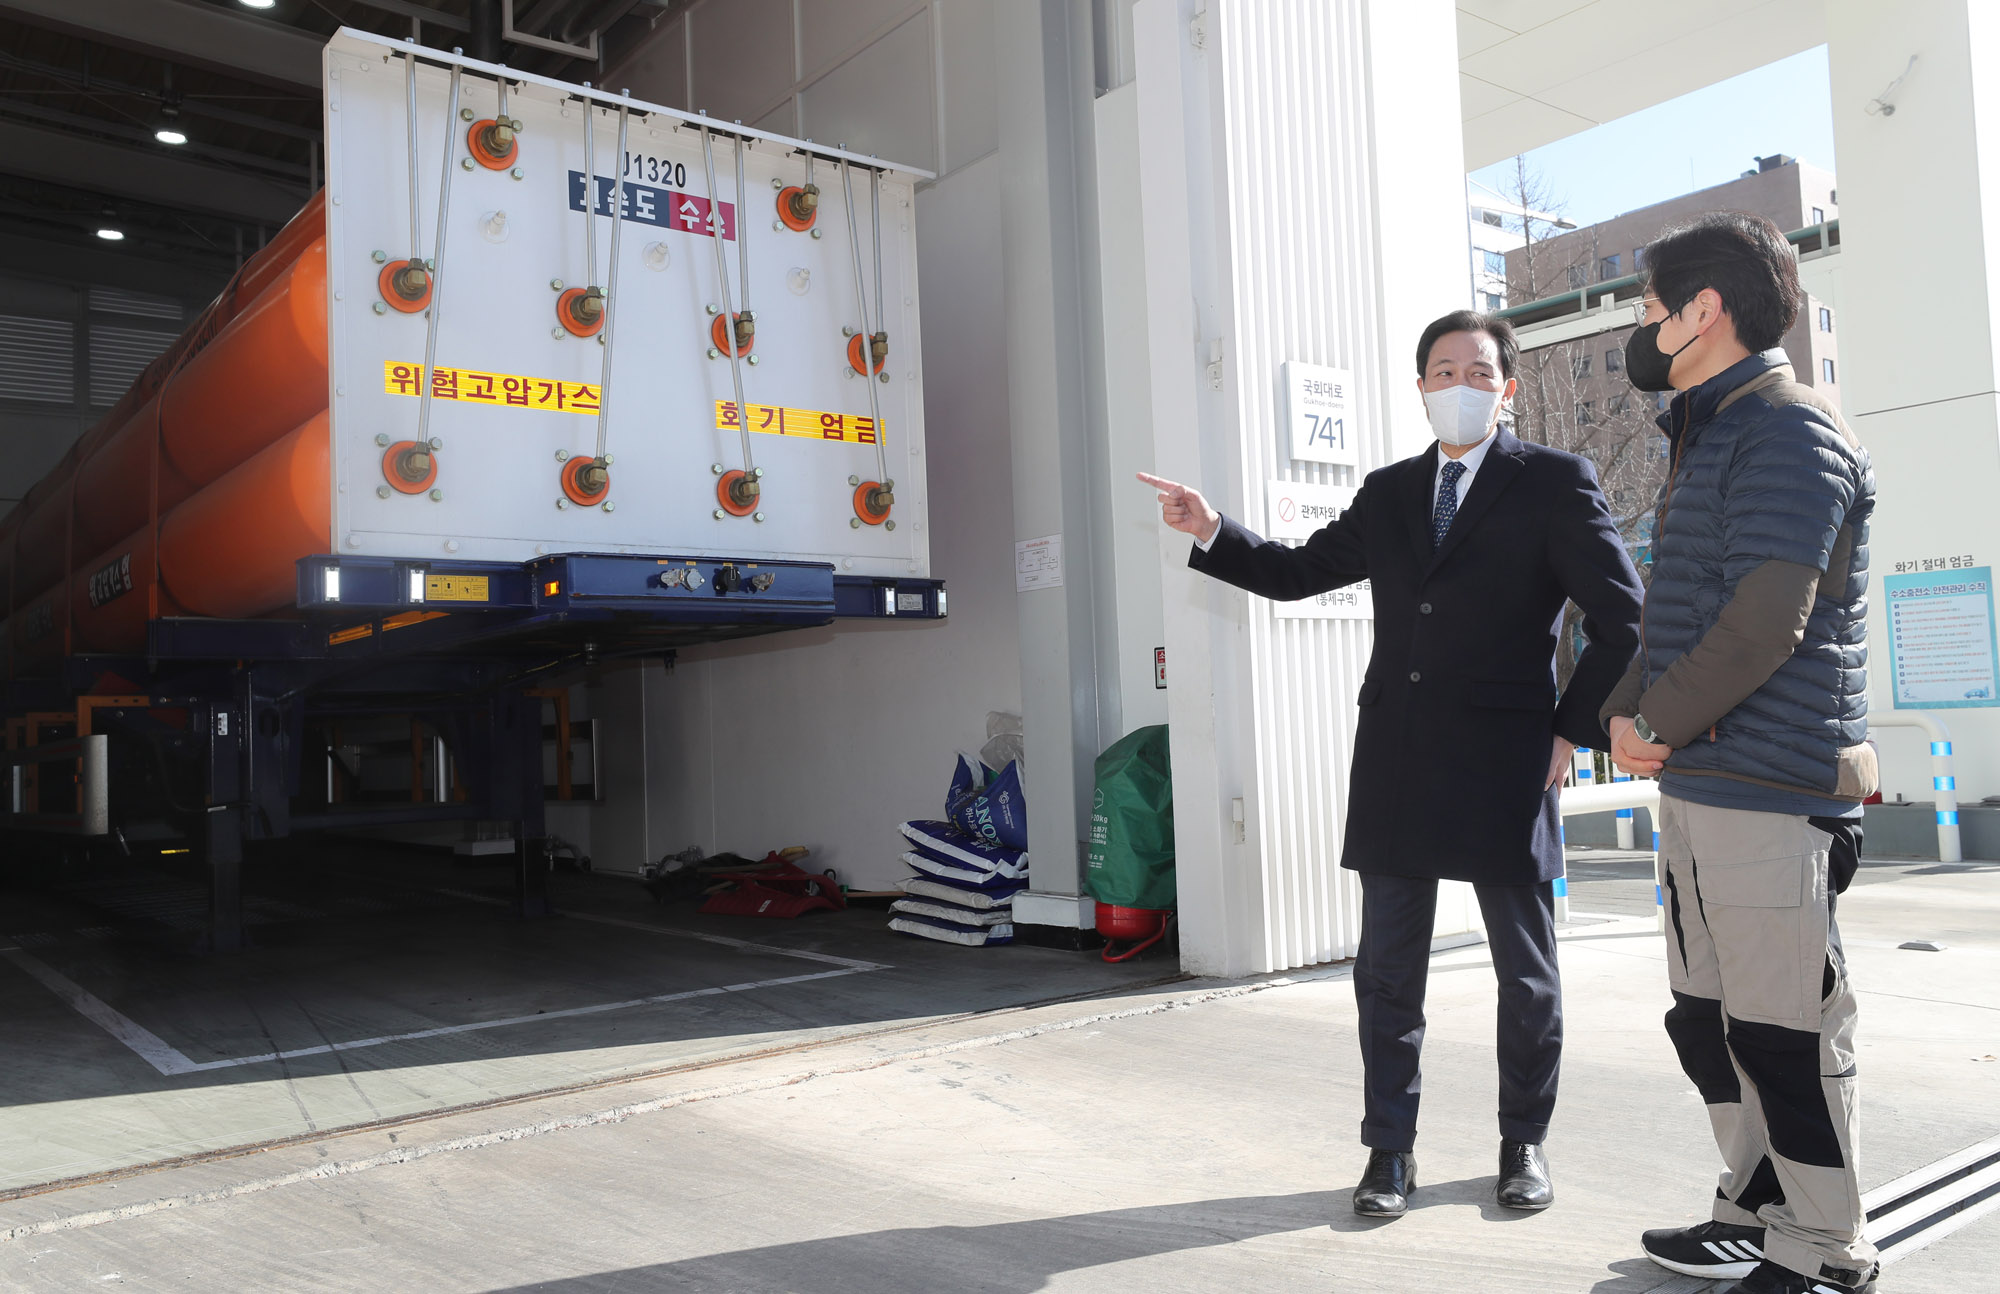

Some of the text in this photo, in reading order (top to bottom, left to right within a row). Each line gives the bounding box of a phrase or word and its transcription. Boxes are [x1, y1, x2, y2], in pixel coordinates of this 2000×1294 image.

[391, 365, 600, 410] 위험고압가스
[1303, 378, 1344, 399] 국회대로
[720, 401, 877, 445] 화기 엄금
[1304, 413, 1344, 450] 741
[1301, 504, 1337, 521] 관계자외
[1895, 554, 1975, 573] 화기 절대 엄금
[1932, 583, 1967, 596] 안전관리
